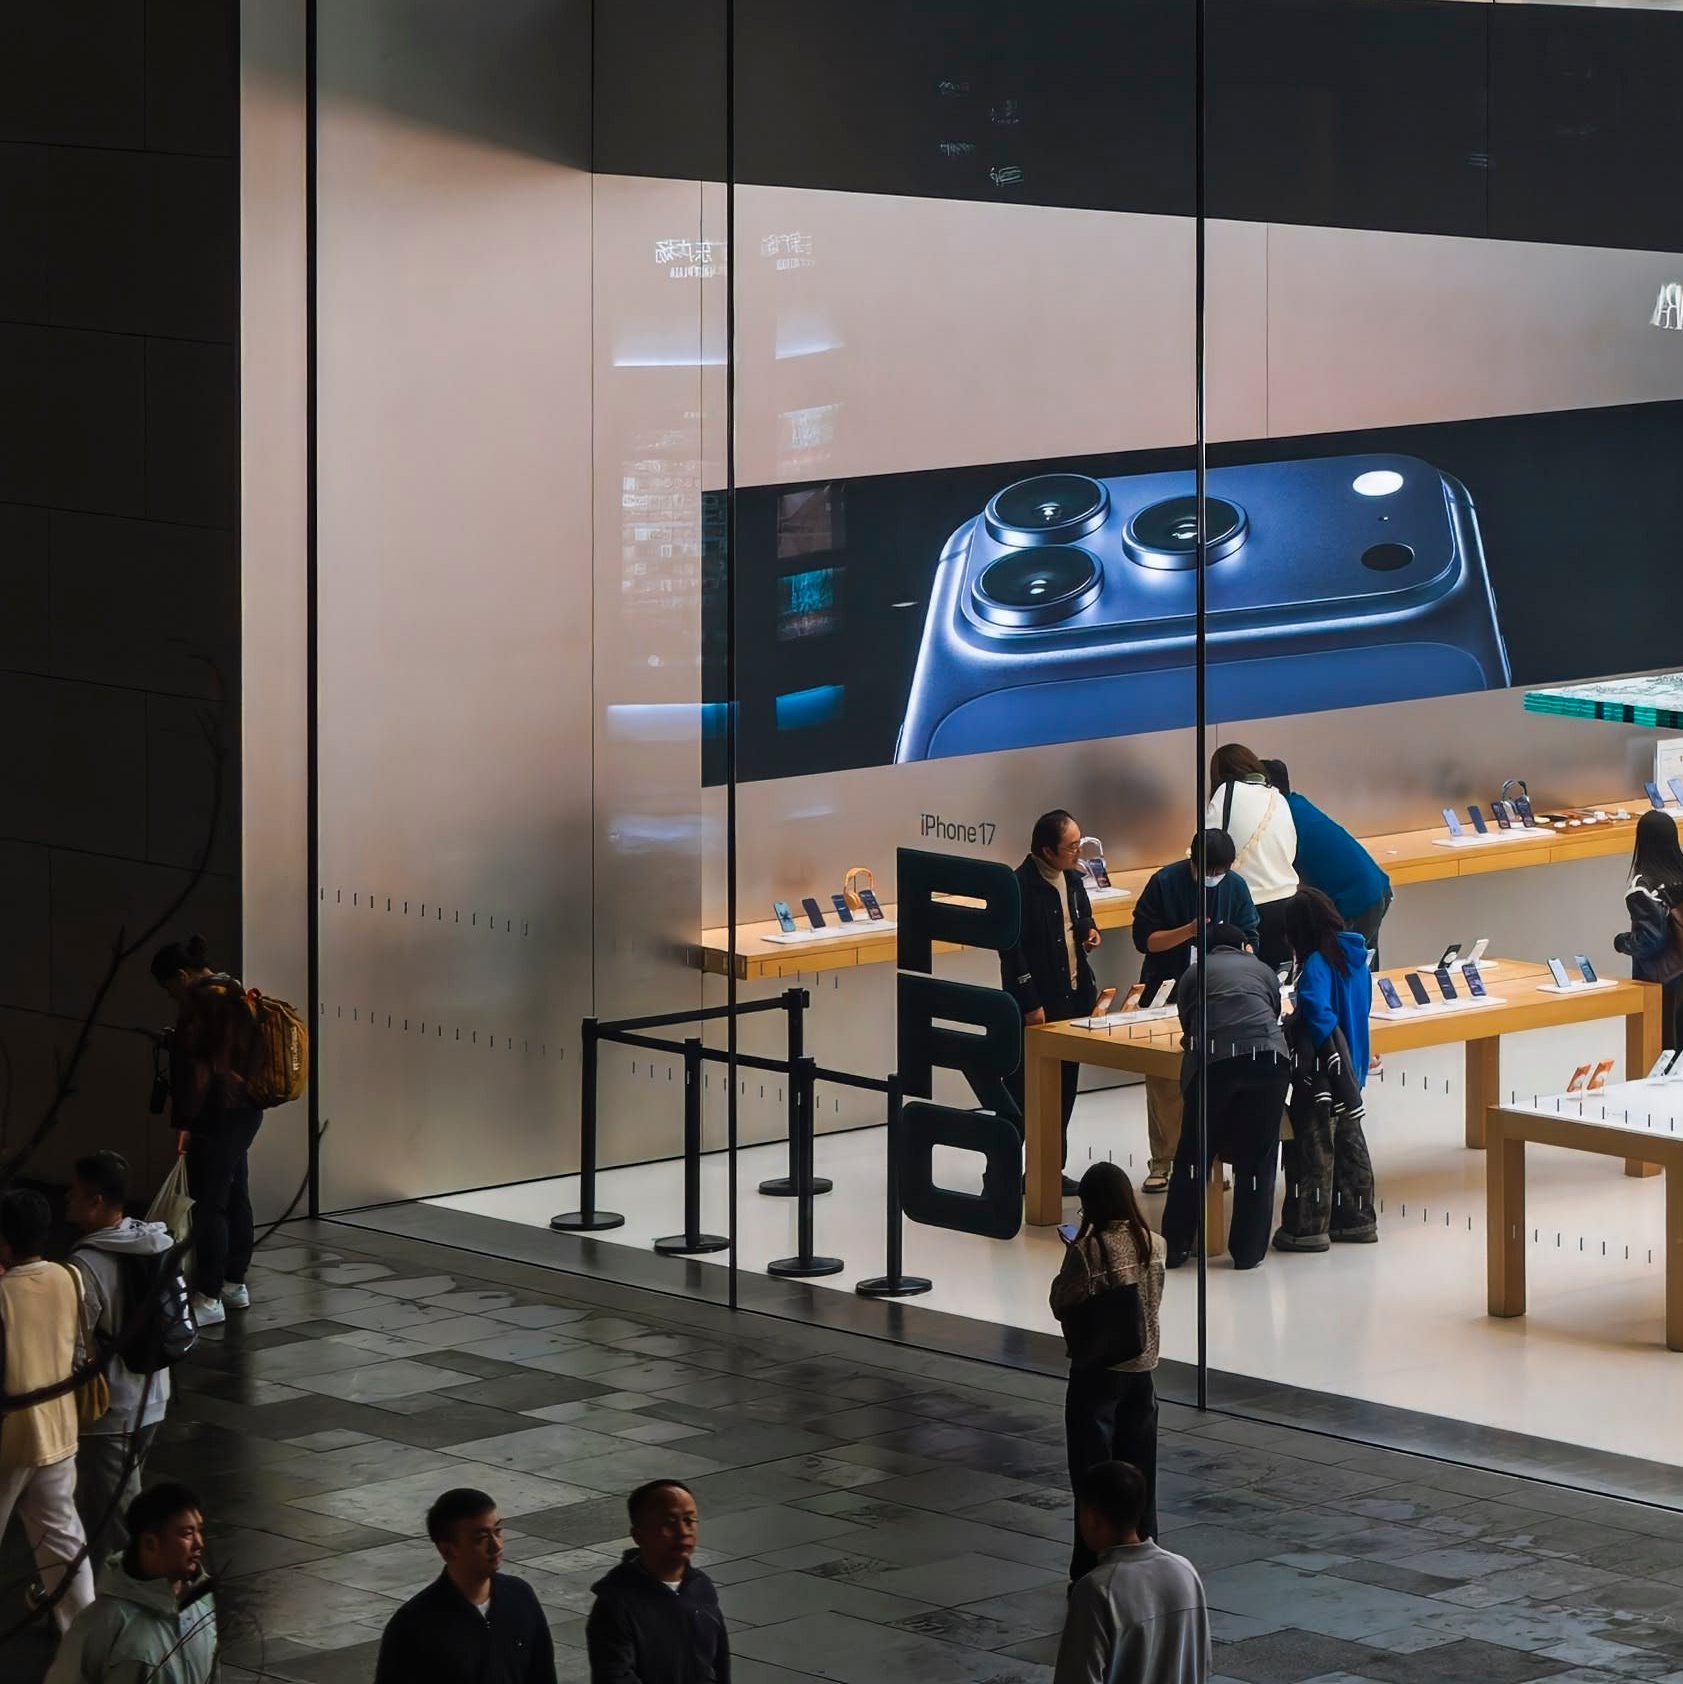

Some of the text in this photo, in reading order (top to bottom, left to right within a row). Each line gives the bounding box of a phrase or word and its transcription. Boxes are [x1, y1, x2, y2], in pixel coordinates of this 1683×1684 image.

[920, 813, 996, 846] iPhone 17
[896, 847, 1024, 1241] PRO
